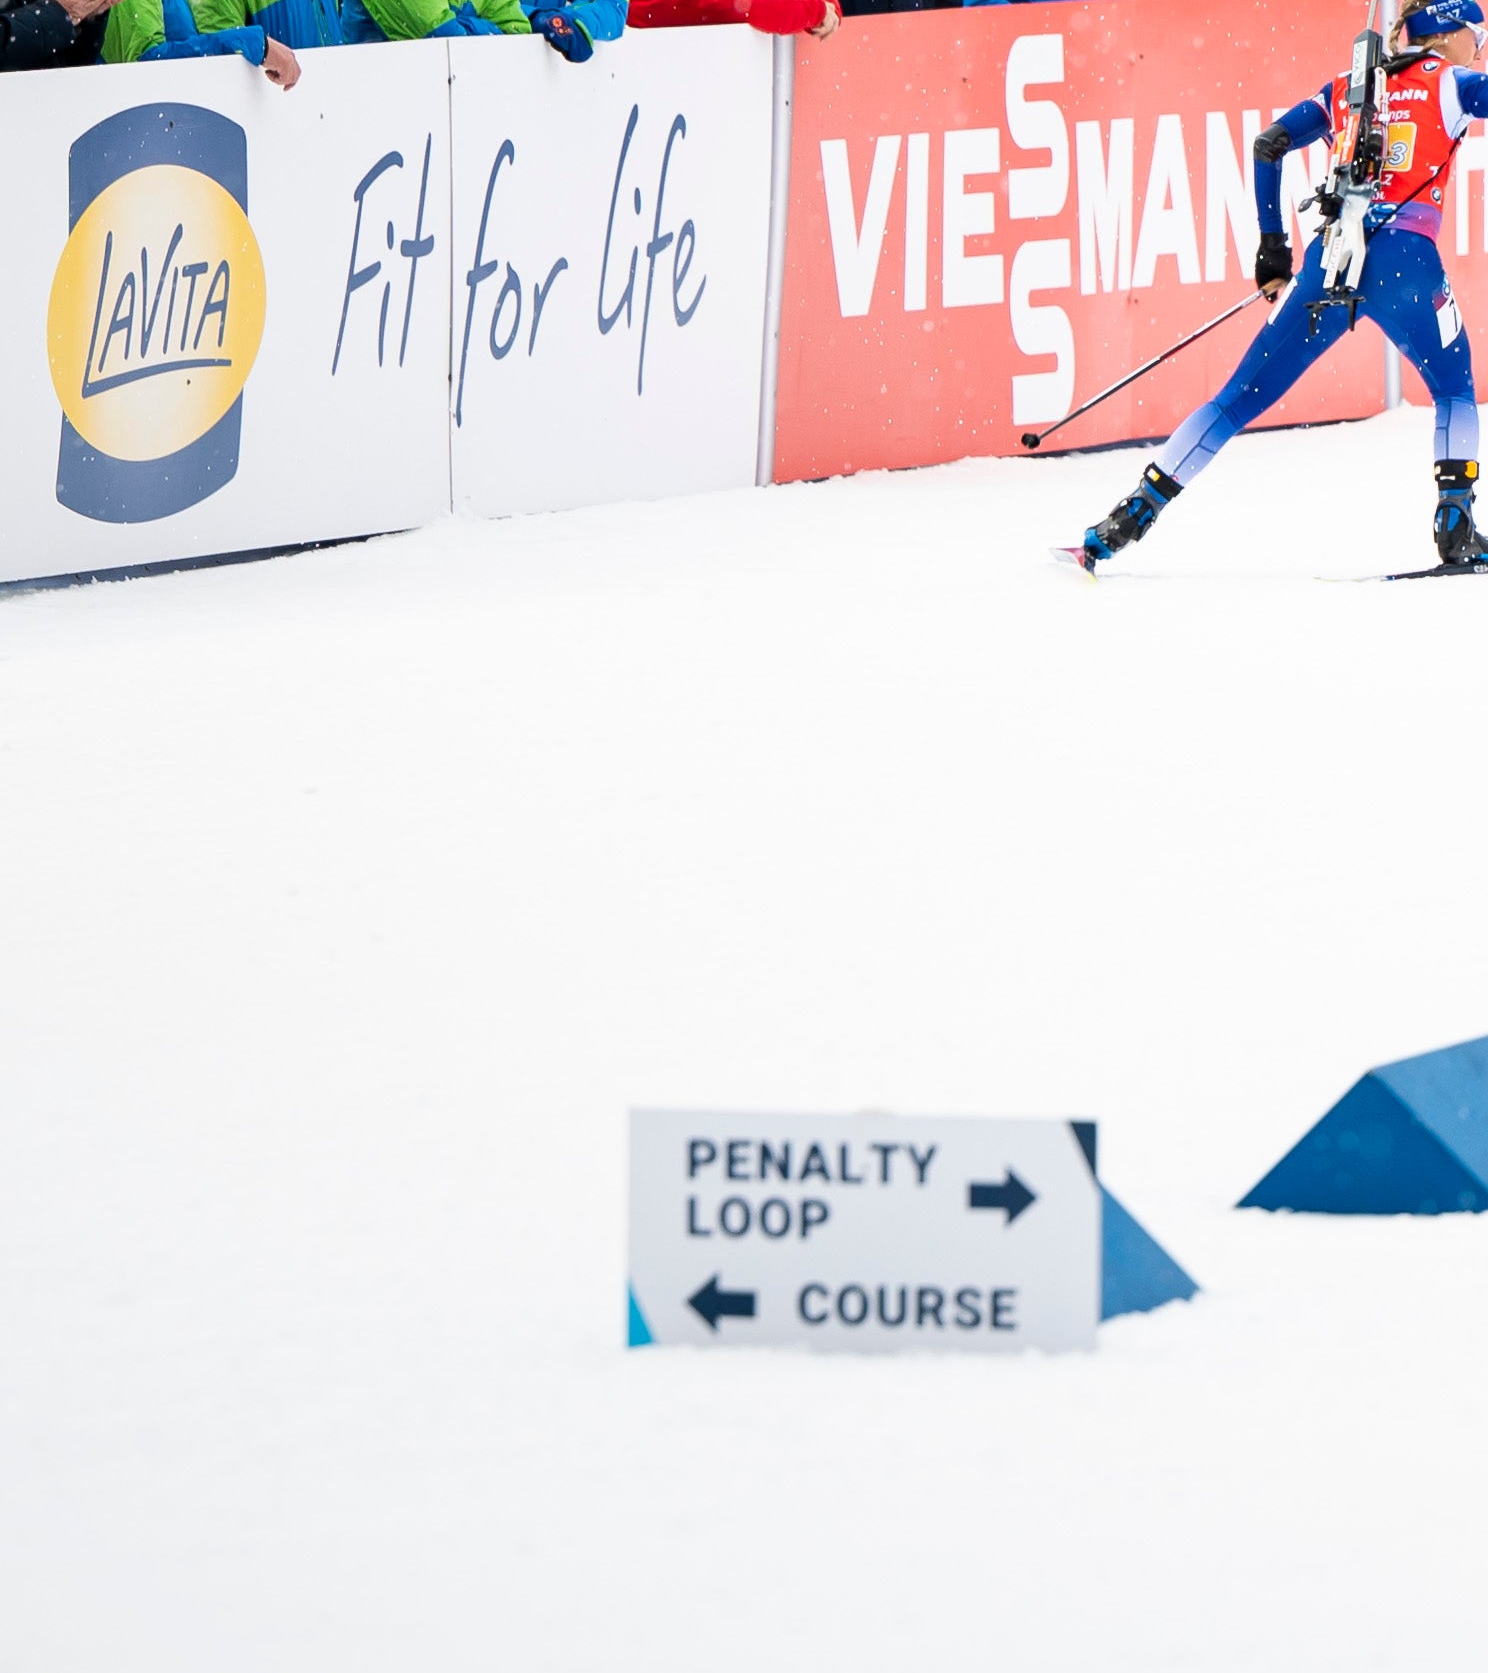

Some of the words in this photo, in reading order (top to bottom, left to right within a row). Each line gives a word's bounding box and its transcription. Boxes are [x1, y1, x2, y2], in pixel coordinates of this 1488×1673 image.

[331, 131, 435, 377] Fit
[454, 137, 569, 428] for
[597, 102, 707, 397] life
[686, 1137, 939, 1187] PENALTY
[686, 1196, 831, 1240] LOOP
[797, 1283, 1020, 1330] COURSE
